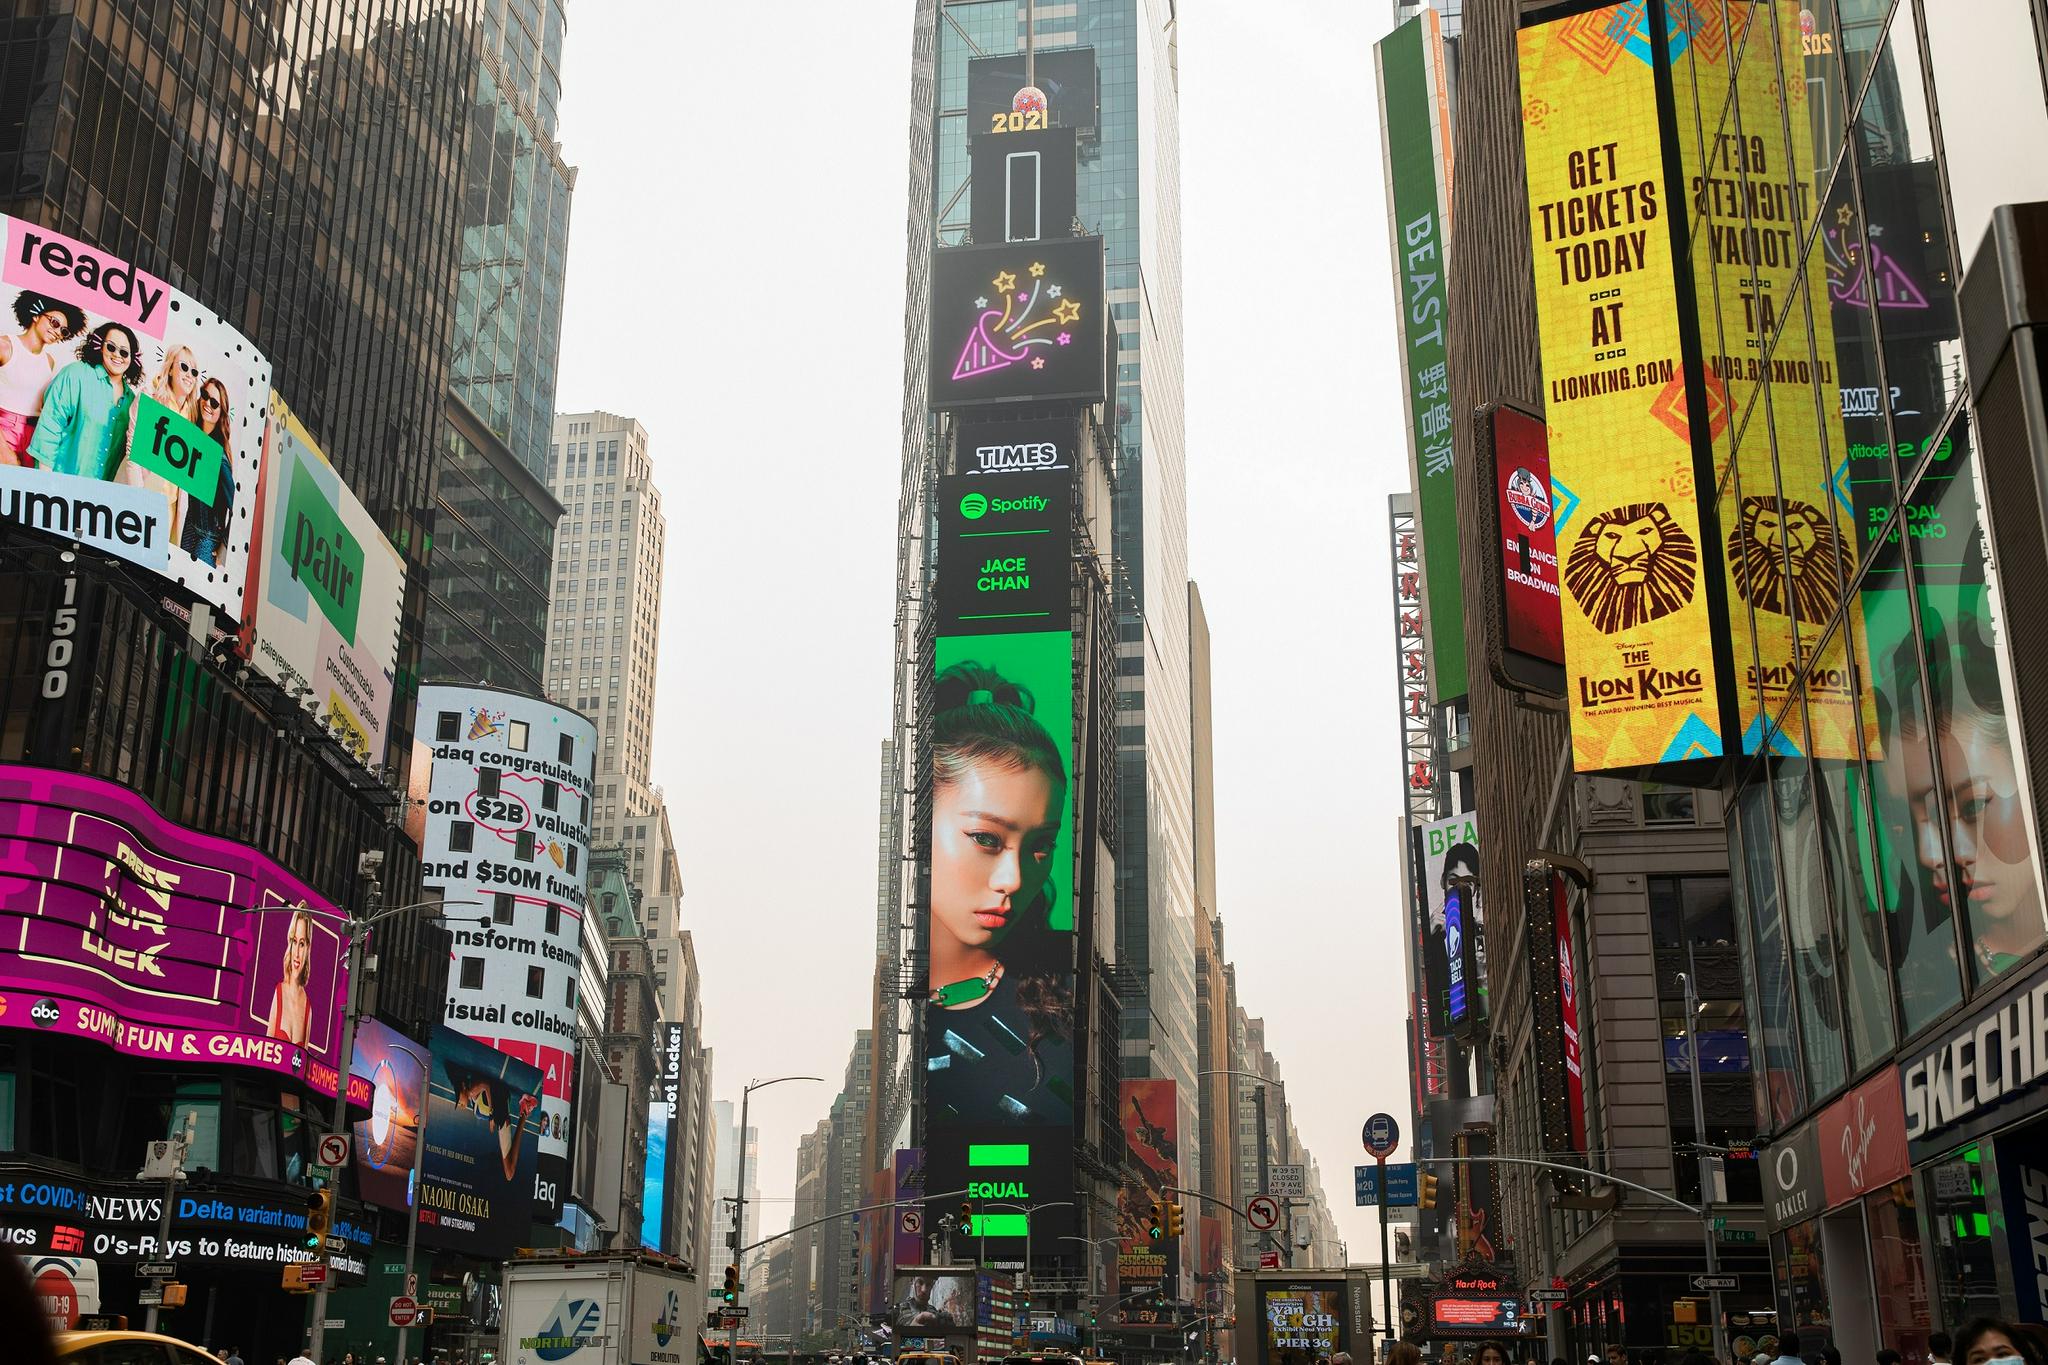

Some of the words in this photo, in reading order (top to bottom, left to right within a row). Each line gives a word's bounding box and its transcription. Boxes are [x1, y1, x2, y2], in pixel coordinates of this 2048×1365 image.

[991, 109, 1048, 134] 2021
[1567, 142, 1618, 191] GET
[1538, 180, 1658, 243] TICKETS
[1555, 230, 1648, 286] TODAY
[20, 232, 163, 324] ready
[1405, 211, 1444, 349] BEAST
[1591, 302, 1624, 347] AT
[1552, 358, 1674, 404] LIONKING.COM
[152, 416, 203, 479] for
[976, 443, 1058, 469] TIMES
[0, 487, 157, 549] ummer
[991, 496, 1049, 514] Spotify
[291, 511, 354, 608] pair
[980, 557, 1027, 574] JACE
[1506, 539, 1558, 567] ENANCE
[976, 575, 1031, 592] CHAN
[1507, 568, 1560, 597] BROADWAY
[42, 578, 77, 699] 1500
[260, 638, 309, 689] paireyewear.com
[1622, 650, 1651, 665] THE
[338, 644, 375, 702] Customizable
[326, 656, 362, 710] prescription
[359, 700, 380, 733] glasses
[1579, 676, 1635, 708] LION
[1637, 667, 1702, 701] KING
[479, 751, 582, 788] congratulates
[1409, 760, 1433, 790] &
[428, 800, 461, 815] on
[475, 797, 524, 824] $2B
[423, 861, 468, 879] and
[475, 860, 542, 891] $50M
[1449, 957, 1463, 974] TACO
[1450, 969, 1464, 985] BELL
[30, 1004, 61, 1021] abc
[77, 1006, 126, 1045] SUMMR
[126, 1026, 175, 1053] FUN
[181, 1034, 201, 1055] &
[208, 1036, 283, 1065] GAMES
[311, 1063, 341, 1092] SUMME
[968, 1182, 1029, 1199] EQUAL
[1357, 1181, 1374, 1191] M20
[90, 1196, 163, 1222] NEWS
[179, 1198, 234, 1221] Delta
[238, 1205, 283, 1228] variant
[284, 1212, 307, 1229] now
[421, 1184, 456, 1211] NAOMI
[458, 1194, 490, 1219] OSAKA
[1775, 1189, 1808, 1222] OAKLEY
[440, 1216, 451, 1227] NOW
[451, 1218, 476, 1232] STREAMING
[1735, 1232, 1745, 1241] 44
[93, 1234, 192, 1260] O's-Rys
[199, 1236, 220, 1257] to
[224, 1238, 274, 1262] feature
[1133, 1246, 1150, 1254] THE
[1119, 1265, 1164, 1279] SQUAD
[1455, 1279, 1478, 1290] Hard
[1477, 1279, 1498, 1291] Rock
[35, 1295, 70, 1314] OVID-19
[1273, 1305, 1305, 1316] van
[1353, 1286, 1363, 1335] Newsstand
[519, 1335, 612, 1350] NORTHEAST
[1276, 1338, 1310, 1348] PIER
[1312, 1338, 1332, 1348] 36
[1667, 1324, 1712, 1345] 150
[650, 1351, 681, 1364] DEMOLITION
